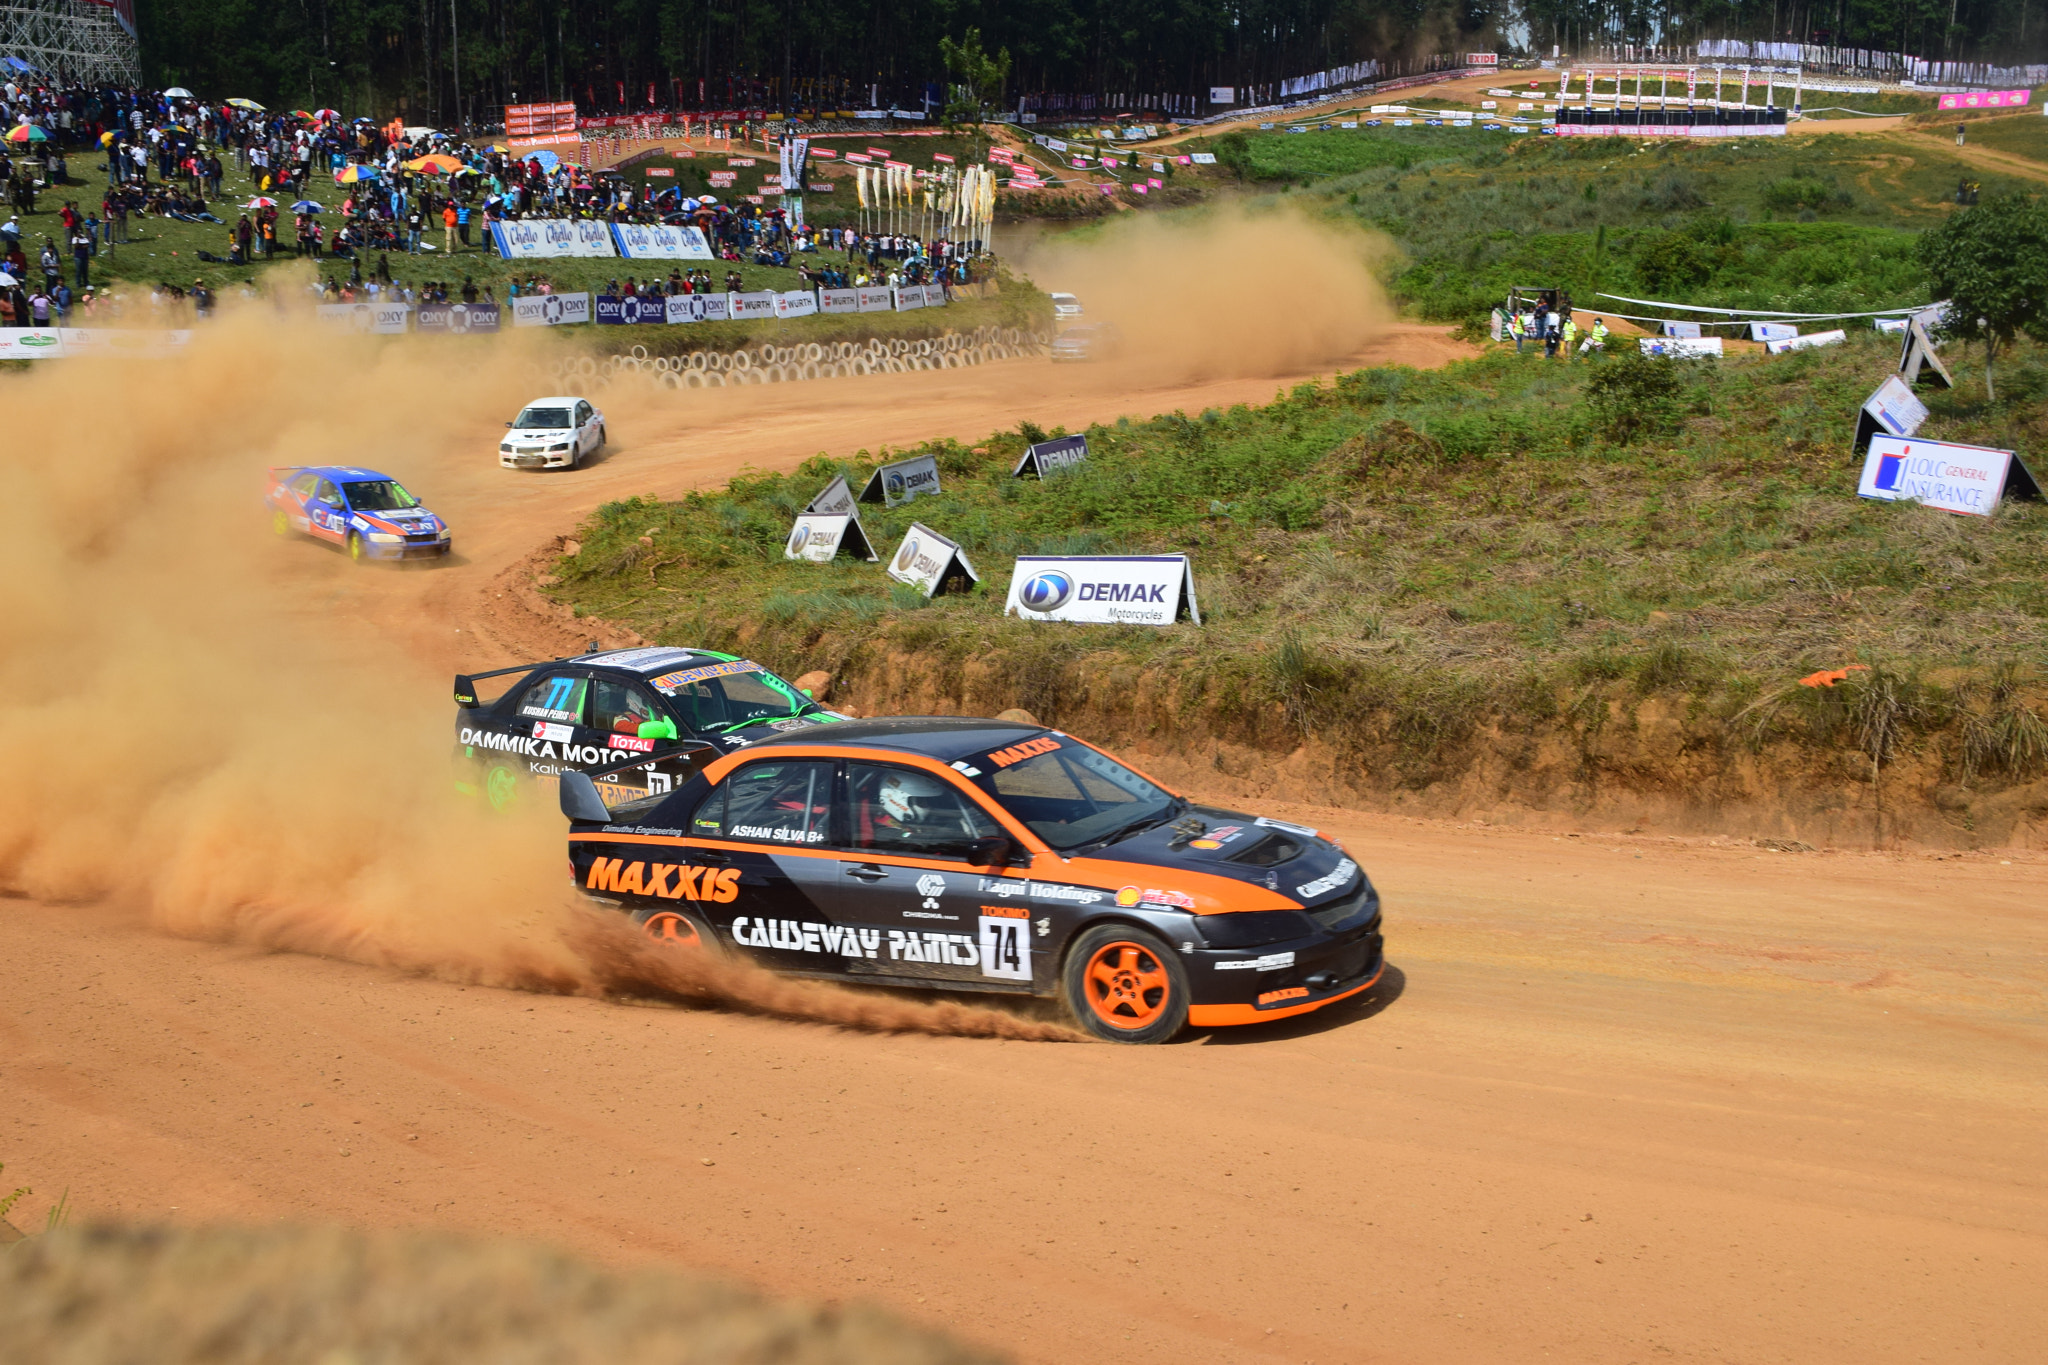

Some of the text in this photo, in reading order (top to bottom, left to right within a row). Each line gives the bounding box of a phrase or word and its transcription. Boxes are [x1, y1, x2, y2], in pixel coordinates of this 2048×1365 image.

[1468, 54, 1496, 63] EXIDE
[517, 304, 541, 315] OXY
[565, 300, 586, 312] OXY
[598, 303, 620, 313] OXY
[642, 303, 663, 314] OXY
[669, 302, 689, 312] OXY
[707, 300, 726, 310] OXY
[377, 311, 403, 322] OXY
[420, 311, 446, 322] OXY
[472, 311, 498, 322] OXY
[1040, 446, 1087, 472] DEMAK
[1911, 457, 1988, 481] LOLC GENERAL
[906, 470, 935, 488] DEMAK
[1905, 478, 1984, 507] INSURANCE
[402, 522, 434, 531] CEAT
[808, 532, 839, 546] DEMAK
[914, 553, 942, 580] DEMAK
[1078, 583, 1168, 603] DEMAK
[1108, 607, 1163, 621] Motorcycles
[651, 666, 718, 690] CAUSEWAY
[544, 676, 575, 710] 77
[522, 705, 550, 718] KUSHAN
[547, 709, 570, 720] PEIRIS
[460, 727, 557, 760] DAMMIKA
[612, 736, 651, 751] TOTAL
[987, 736, 1062, 768] MAXXIS
[651, 777, 664, 796] 77
[602, 824, 683, 838] Dimuthu Engineering
[730, 825, 824, 843] ASHAN SILVA B+
[586, 856, 743, 904] MAXXIS
[1030, 882, 1103, 904] Holdings
[732, 916, 880, 959] CAUSEWAY
[989, 925, 1021, 972] 74
